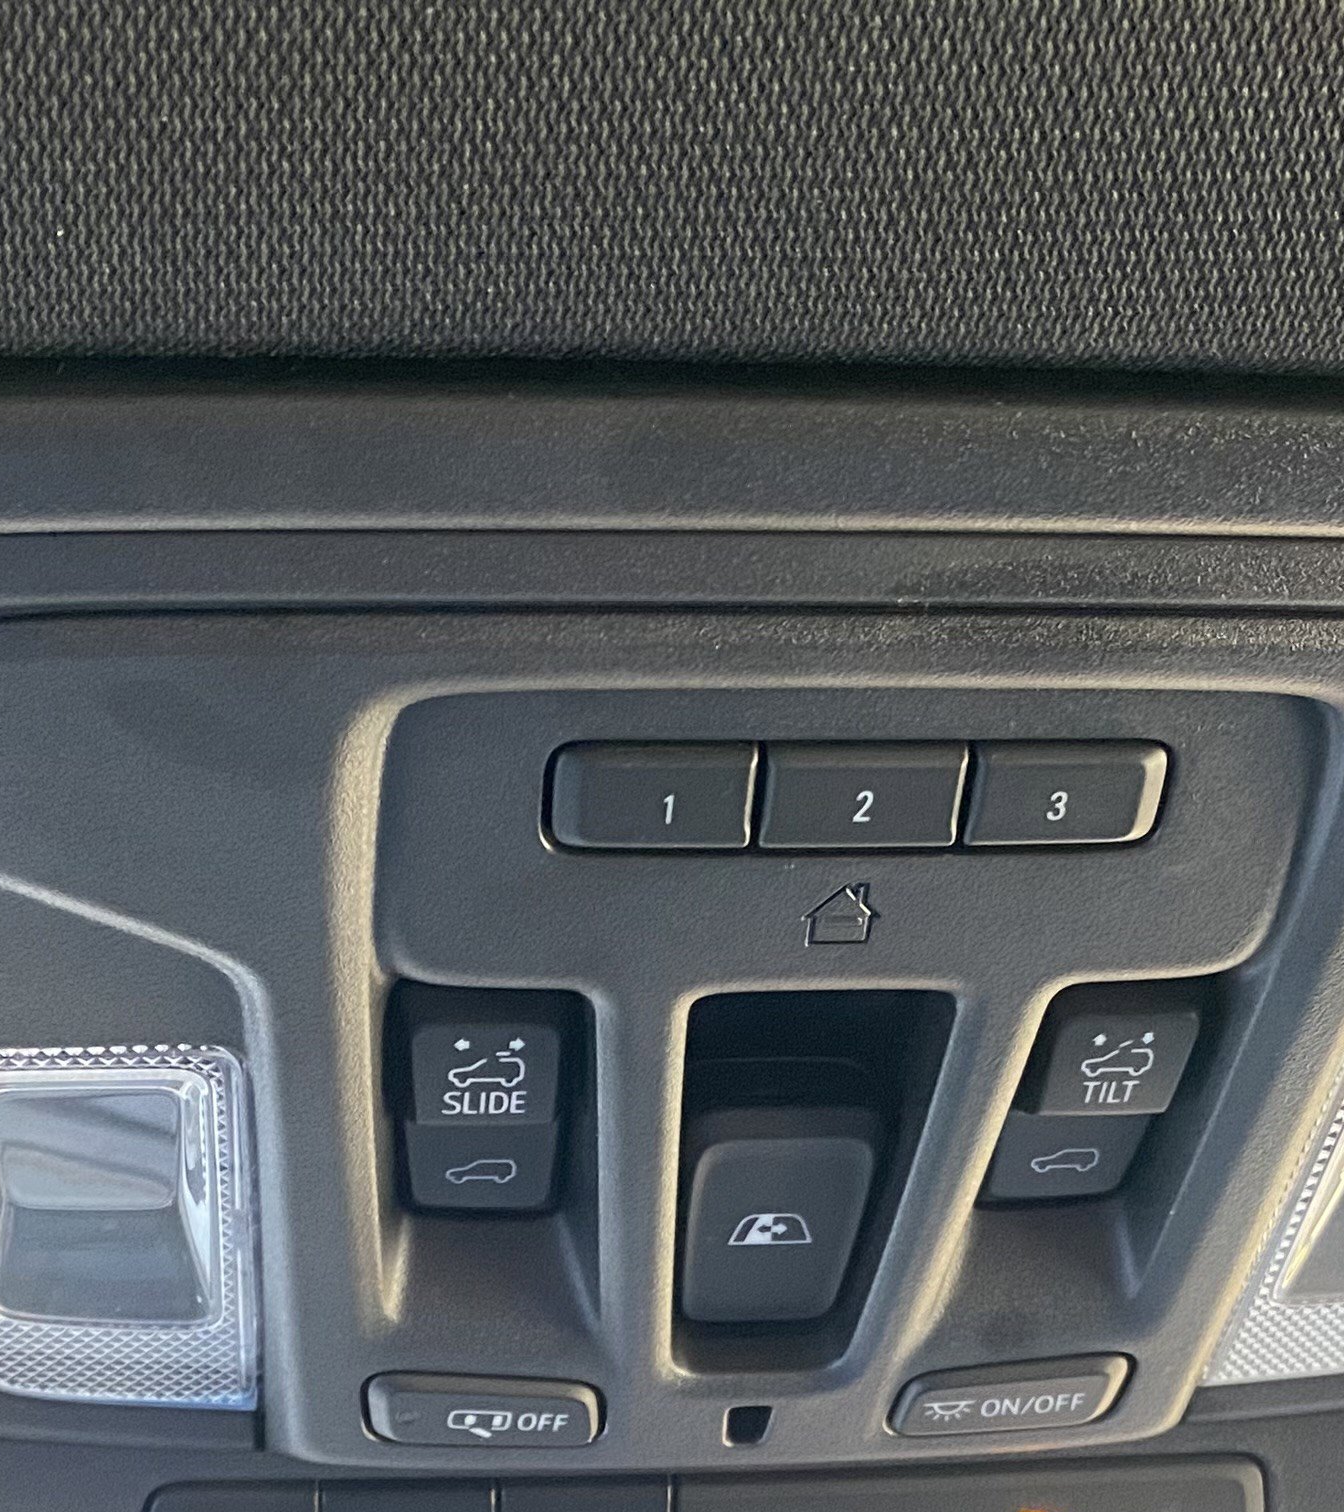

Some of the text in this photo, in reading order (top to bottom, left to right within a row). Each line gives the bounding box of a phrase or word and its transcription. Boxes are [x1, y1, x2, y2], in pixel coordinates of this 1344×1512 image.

[662, 795, 675, 825] 1
[852, 790, 873, 822] 2
[1046, 791, 1068, 821] 3
[441, 1090, 527, 1115] SLIDE
[1082, 1079, 1139, 1104] TILT
[980, 1392, 1087, 1418] ON/OFF
[517, 1413, 568, 1432] OFF
